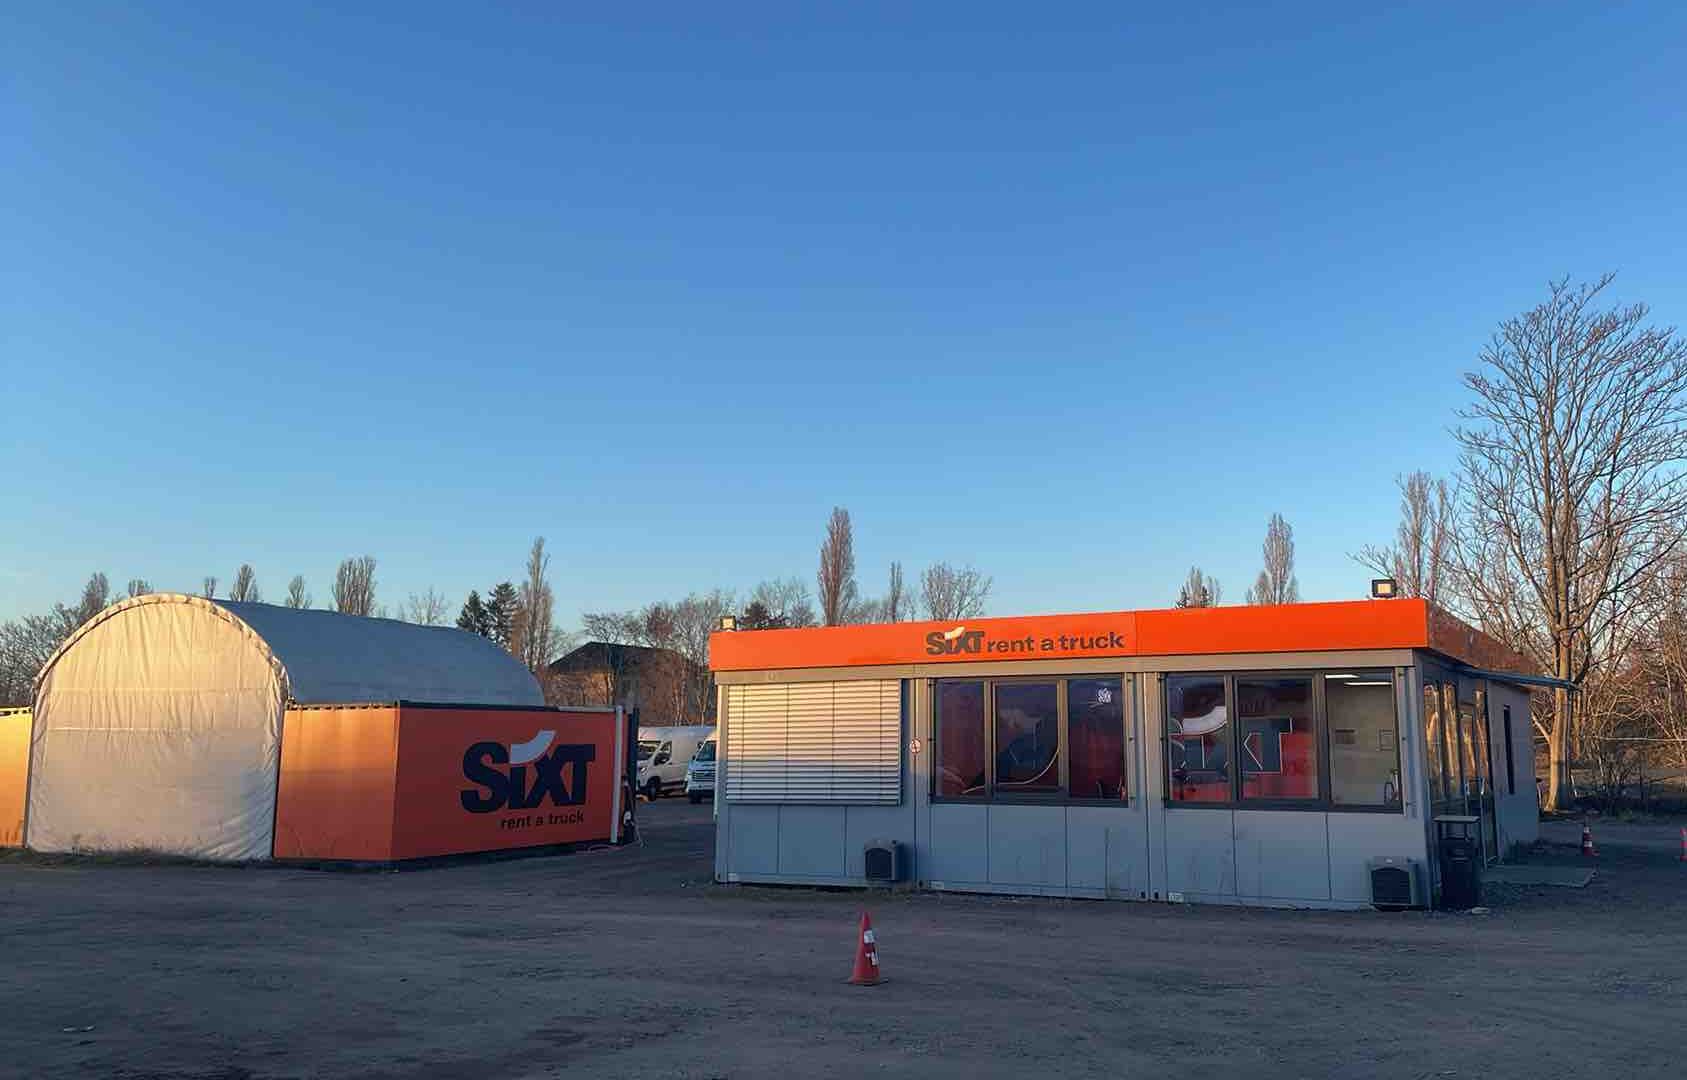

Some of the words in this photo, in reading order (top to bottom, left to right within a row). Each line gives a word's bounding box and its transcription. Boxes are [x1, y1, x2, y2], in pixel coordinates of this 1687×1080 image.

[987, 636, 1035, 652] rent
[1041, 639, 1056, 651] a
[1060, 632, 1124, 650] truck
[501, 815, 531, 829] rent
[536, 815, 545, 826] a
[548, 810, 585, 825] truck
